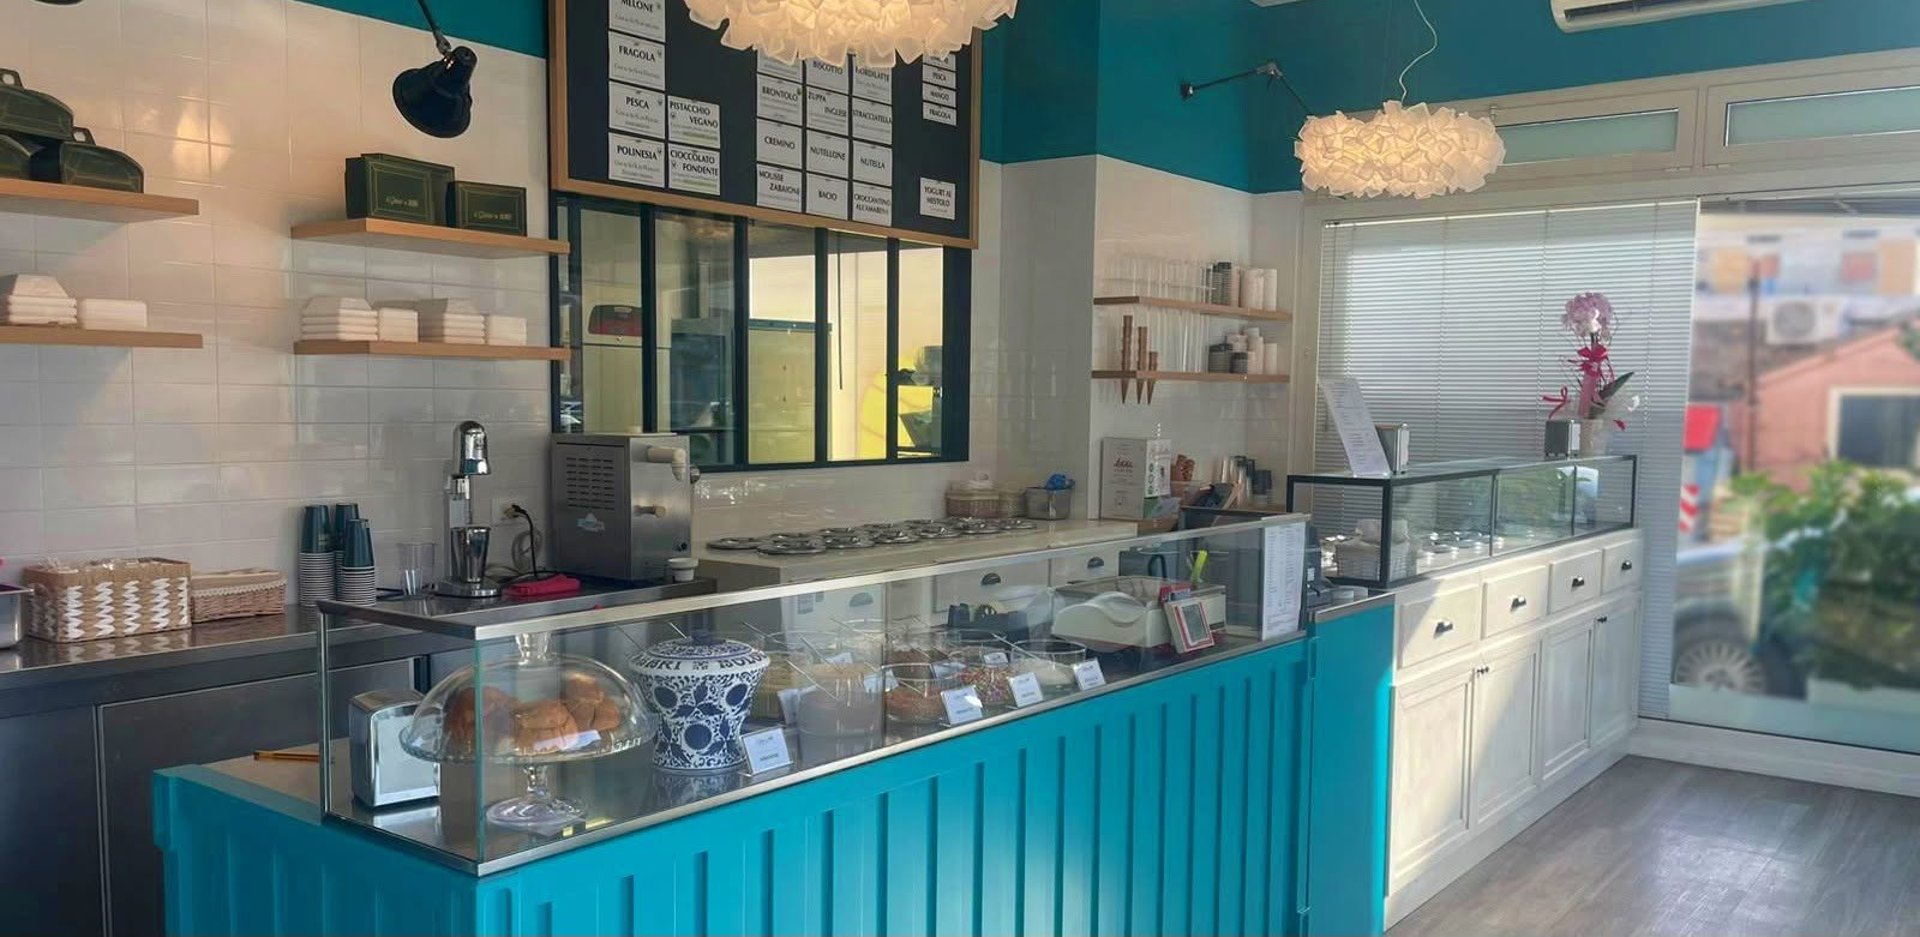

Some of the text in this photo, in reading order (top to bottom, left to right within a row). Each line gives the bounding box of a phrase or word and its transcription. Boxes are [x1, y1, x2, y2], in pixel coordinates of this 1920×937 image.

[618, 45, 656, 62] FRAGOLA
[813, 60, 843, 75] BISCOTTO
[762, 85, 799, 102] BRONTOLO
[808, 91, 826, 102] ZUPPA
[930, 91, 950, 101] MANGO
[625, 96, 649, 110] PESCA
[670, 101, 711, 116] PISTACCHIO
[824, 106, 847, 117] INGLESE
[851, 108, 893, 124] STRACCIATELLA
[929, 108, 951, 119] FRAGOLA
[689, 116, 719, 128] VEGANO
[764, 136, 796, 150] CREMINO
[617, 145, 658, 160] POLINESIA
[670, 149, 715, 164] CIOCCOLATO
[809, 146, 846, 161] NUTELLONE
[682, 162, 719, 176] FONDENTE
[860, 157, 885, 169] NUTELLA
[759, 170, 784, 182] MOUSSE
[769, 182, 800, 195] ZABAIONE
[924, 186, 945, 197] YOGURT
[818, 190, 838, 202] BACIO
[854, 193, 891, 206] CROCCANTINO
[927, 197, 950, 207] MESTOLO
